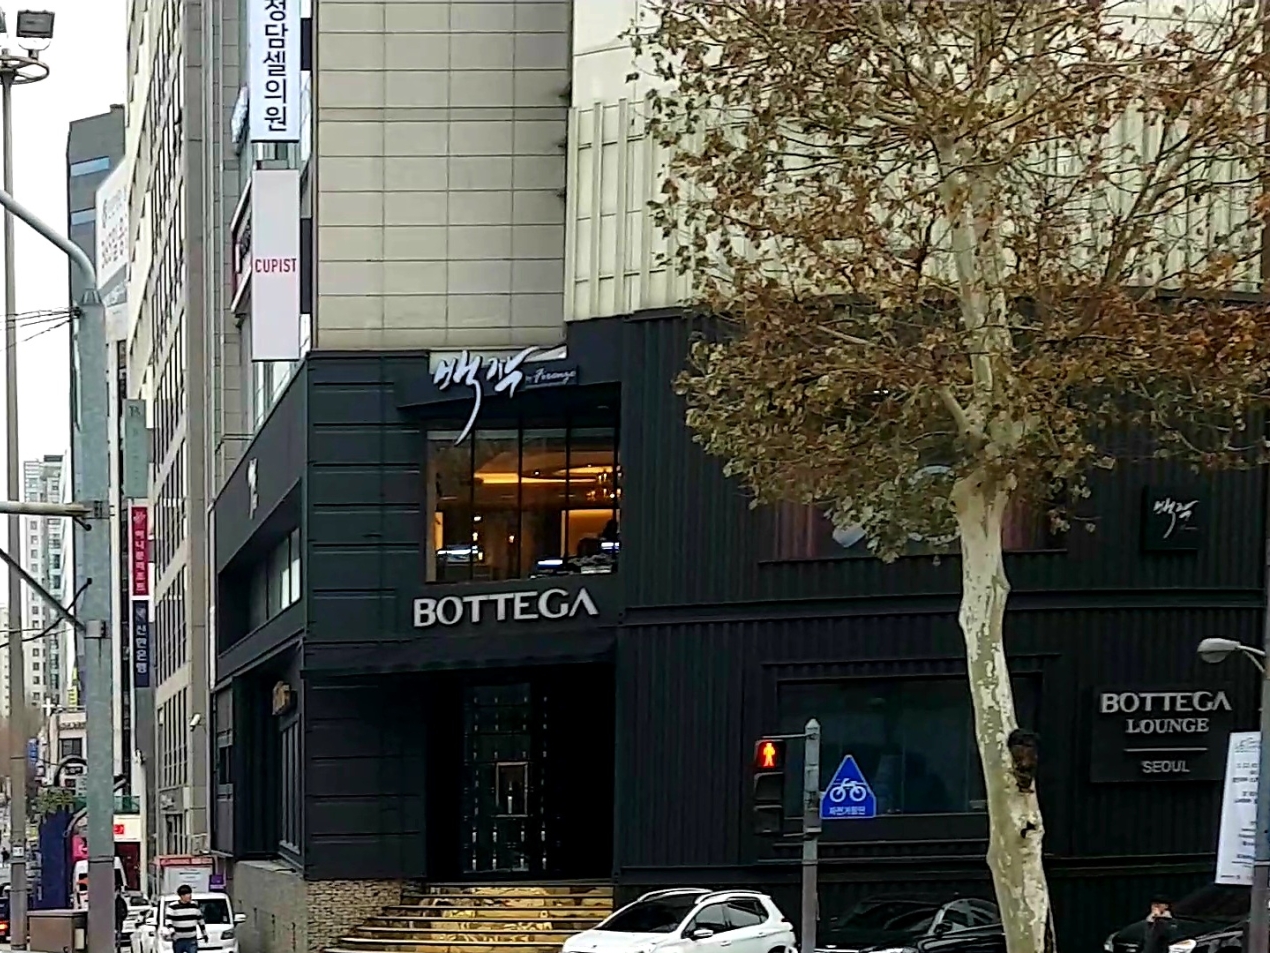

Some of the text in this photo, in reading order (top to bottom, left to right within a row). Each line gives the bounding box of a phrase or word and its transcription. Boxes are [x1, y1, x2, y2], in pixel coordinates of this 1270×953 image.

[255, 258, 297, 274] CUPIST
[413, 587, 599, 628] BOTTEGA
[1101, 690, 1232, 713] BOTTEGA
[1125, 718, 1210, 734] LOUNGE
[1141, 760, 1190, 773] SEOUL
